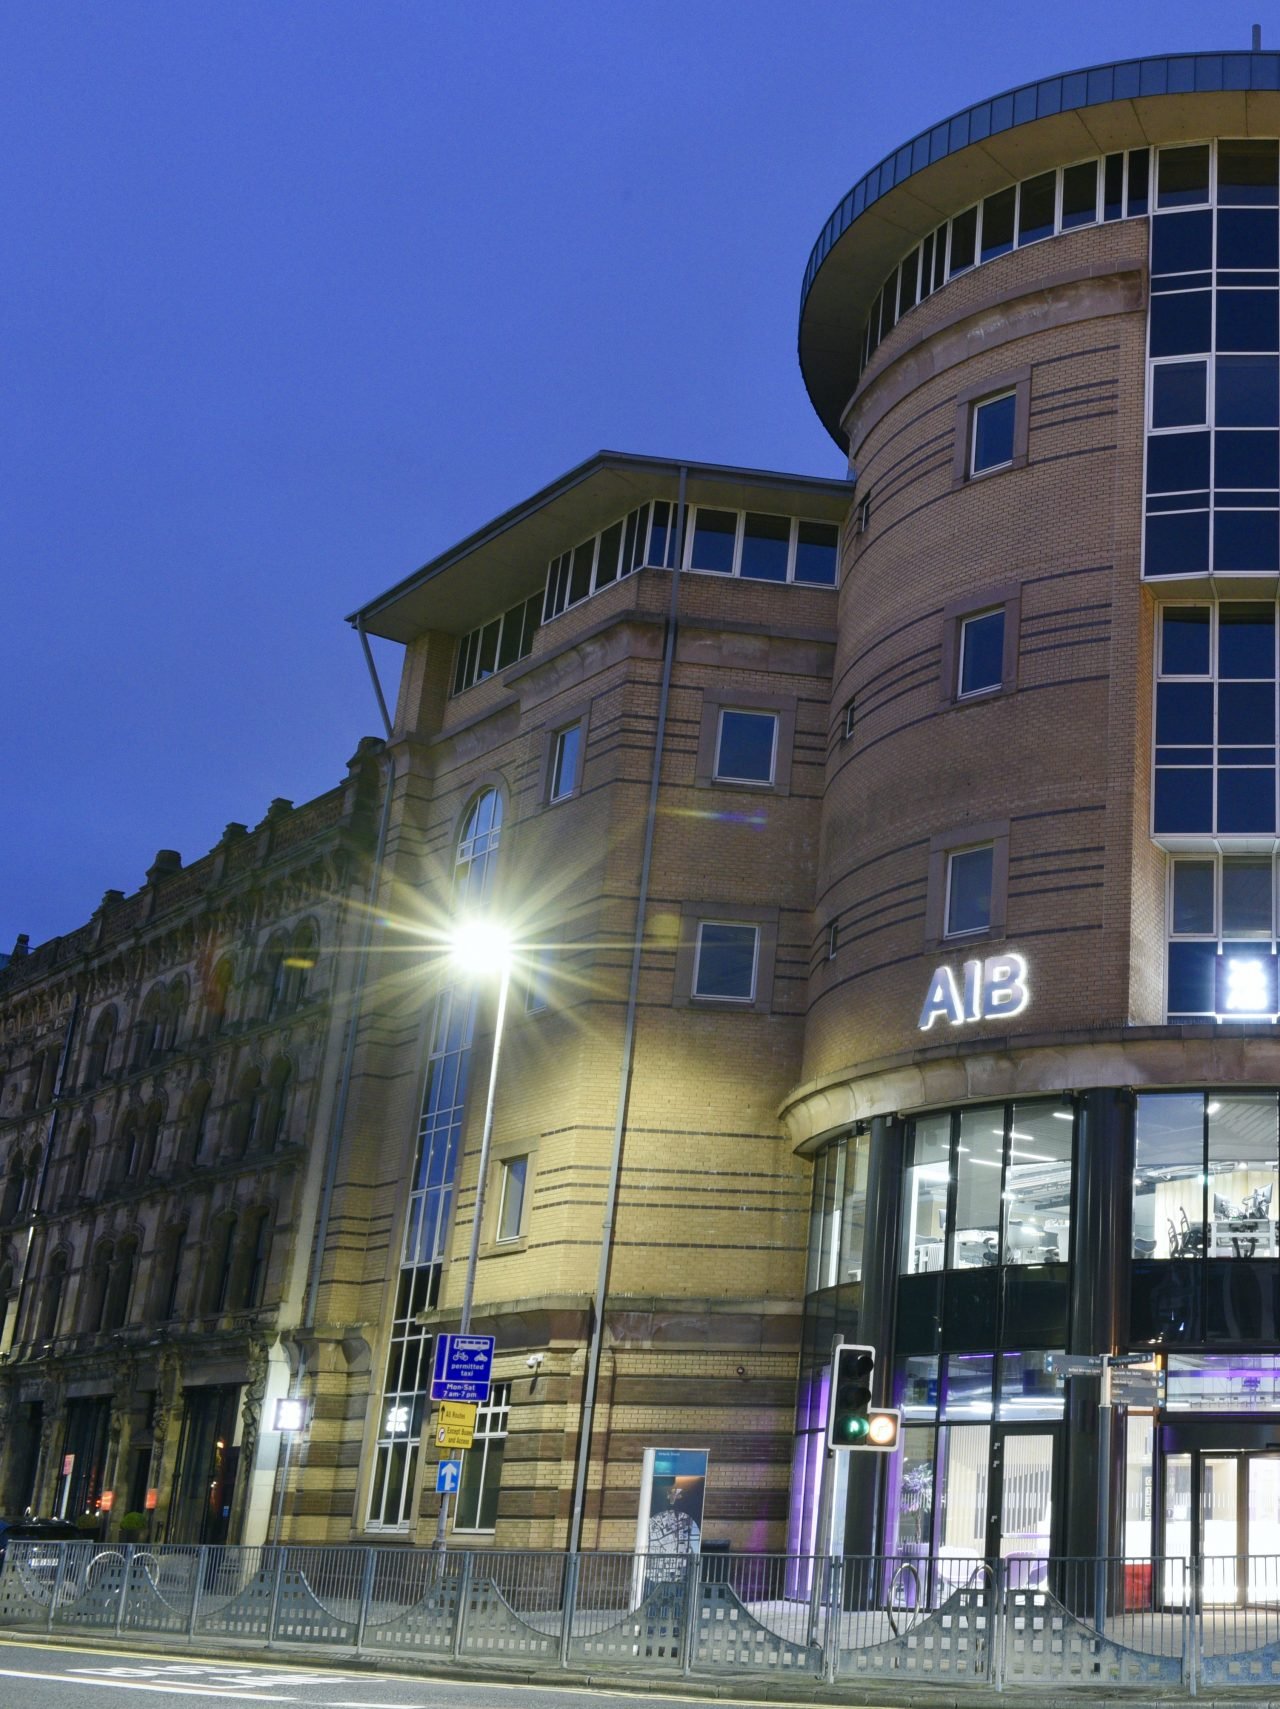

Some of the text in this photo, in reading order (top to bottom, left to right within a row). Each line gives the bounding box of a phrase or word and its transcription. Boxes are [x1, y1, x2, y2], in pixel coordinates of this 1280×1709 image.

[918, 953, 1029, 1031] AIB
[446, 1383, 475, 1391] Mon-Sat
[66, 1665, 253, 1678] BUS
